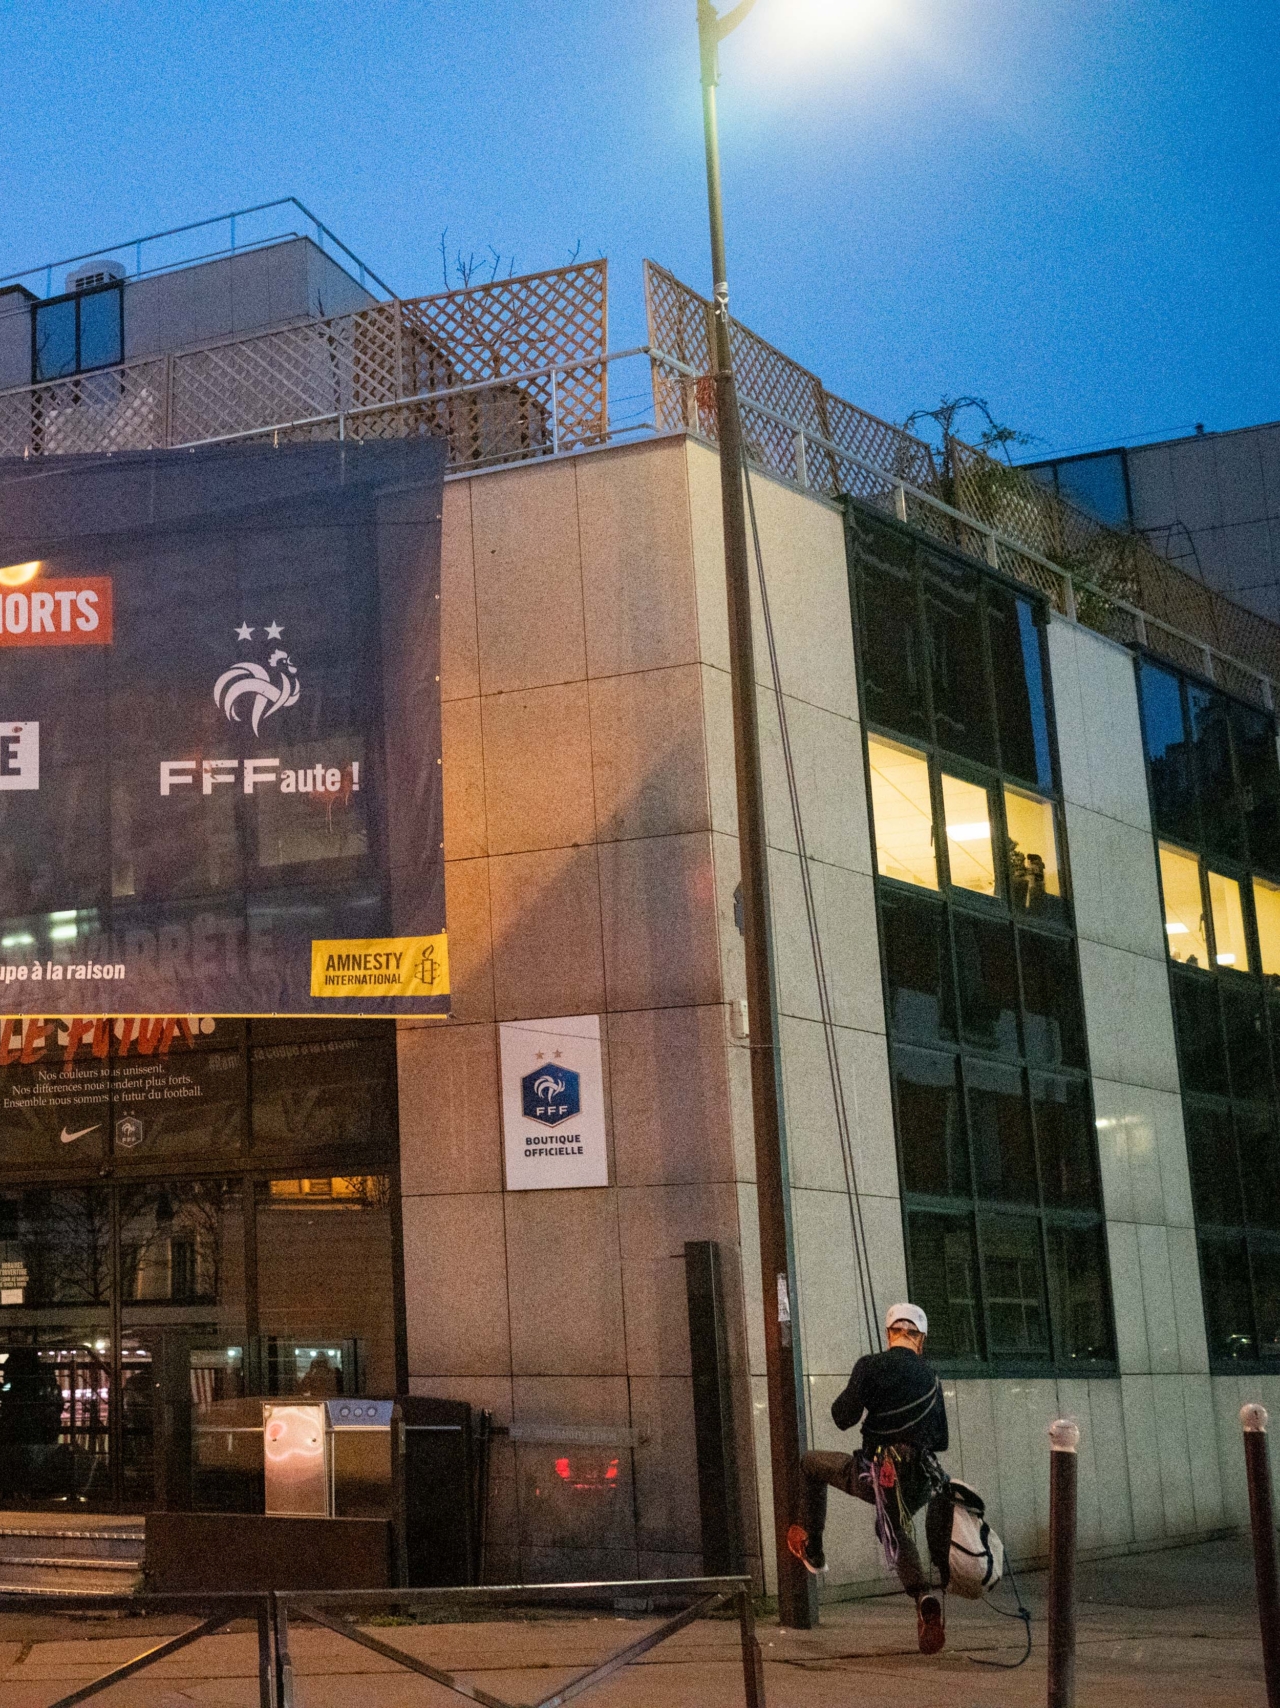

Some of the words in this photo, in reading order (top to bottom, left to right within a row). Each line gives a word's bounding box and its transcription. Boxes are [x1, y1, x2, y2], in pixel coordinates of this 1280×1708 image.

[352, 762, 360, 791] !
[31, 961, 42, 980] à
[46, 961, 63, 980] la
[66, 960, 125, 980] raison
[325, 952, 403, 972] AMNESTY
[324, 972, 403, 986] INTERNATIONAL
[38, 1070, 57, 1082] Nos
[59, 1068, 99, 1080] couleurs
[122, 1064, 166, 1077] unissent.
[12, 1085, 31, 1096] Nos
[145, 1076, 167, 1092] plus
[168, 1073, 193, 1086] forts.
[3, 1097, 47, 1109] Ensemble
[49, 1096, 72, 1106] nous
[122, 1089, 146, 1102] futur
[148, 1089, 161, 1099] du
[164, 1085, 204, 1098] football.
[536, 1105, 568, 1116] FFF
[525, 1134, 581, 1145] BOUTIQUE
[524, 1145, 584, 1157] OFFICIELLE
